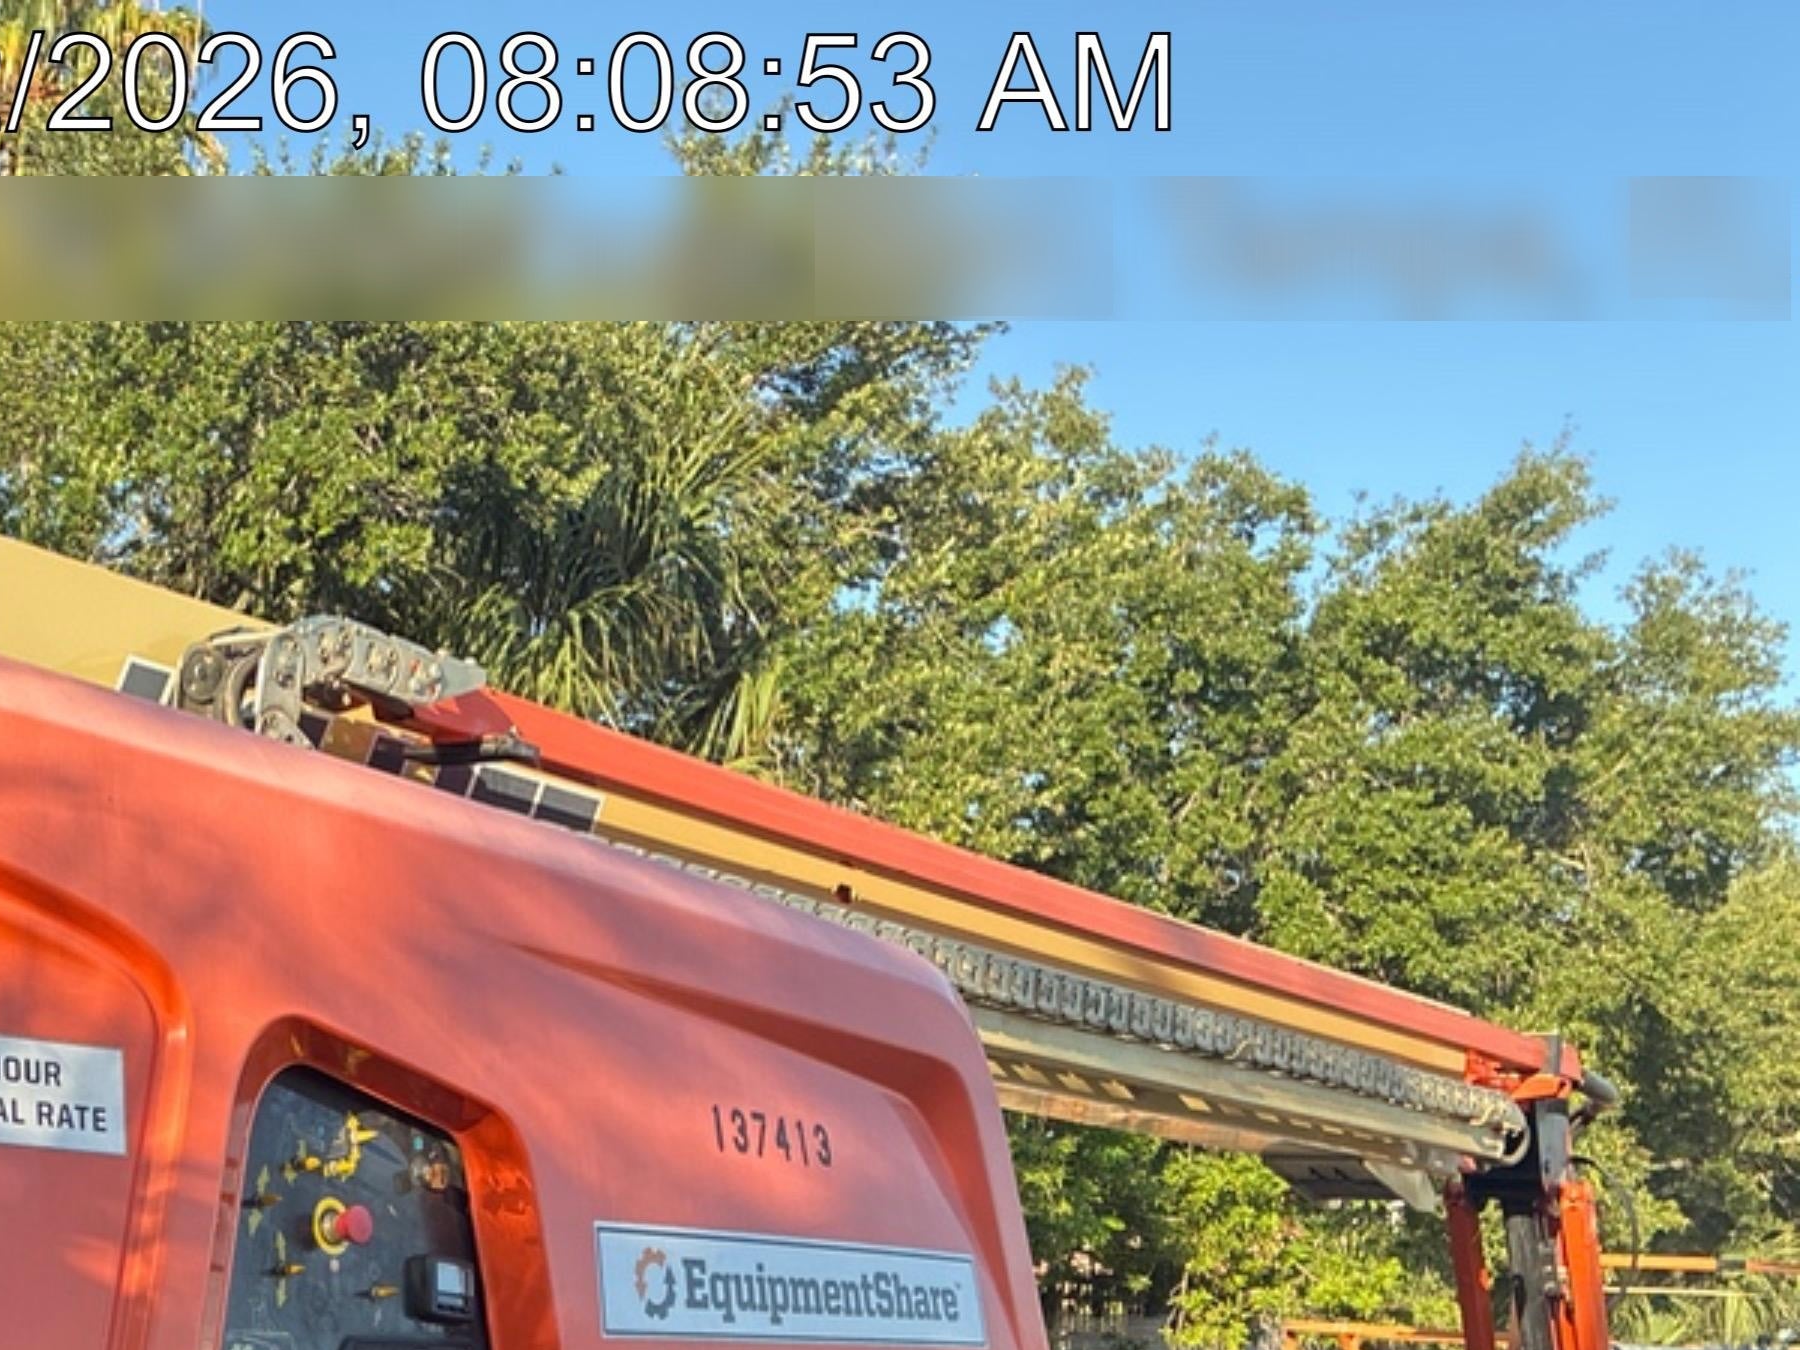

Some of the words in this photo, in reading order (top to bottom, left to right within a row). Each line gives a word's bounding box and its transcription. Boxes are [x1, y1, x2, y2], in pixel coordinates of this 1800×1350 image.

[37, 1101, 107, 1132] RATE
[712, 1105, 832, 1167] 137413
[682, 1258, 959, 1325] EquipmentShare
